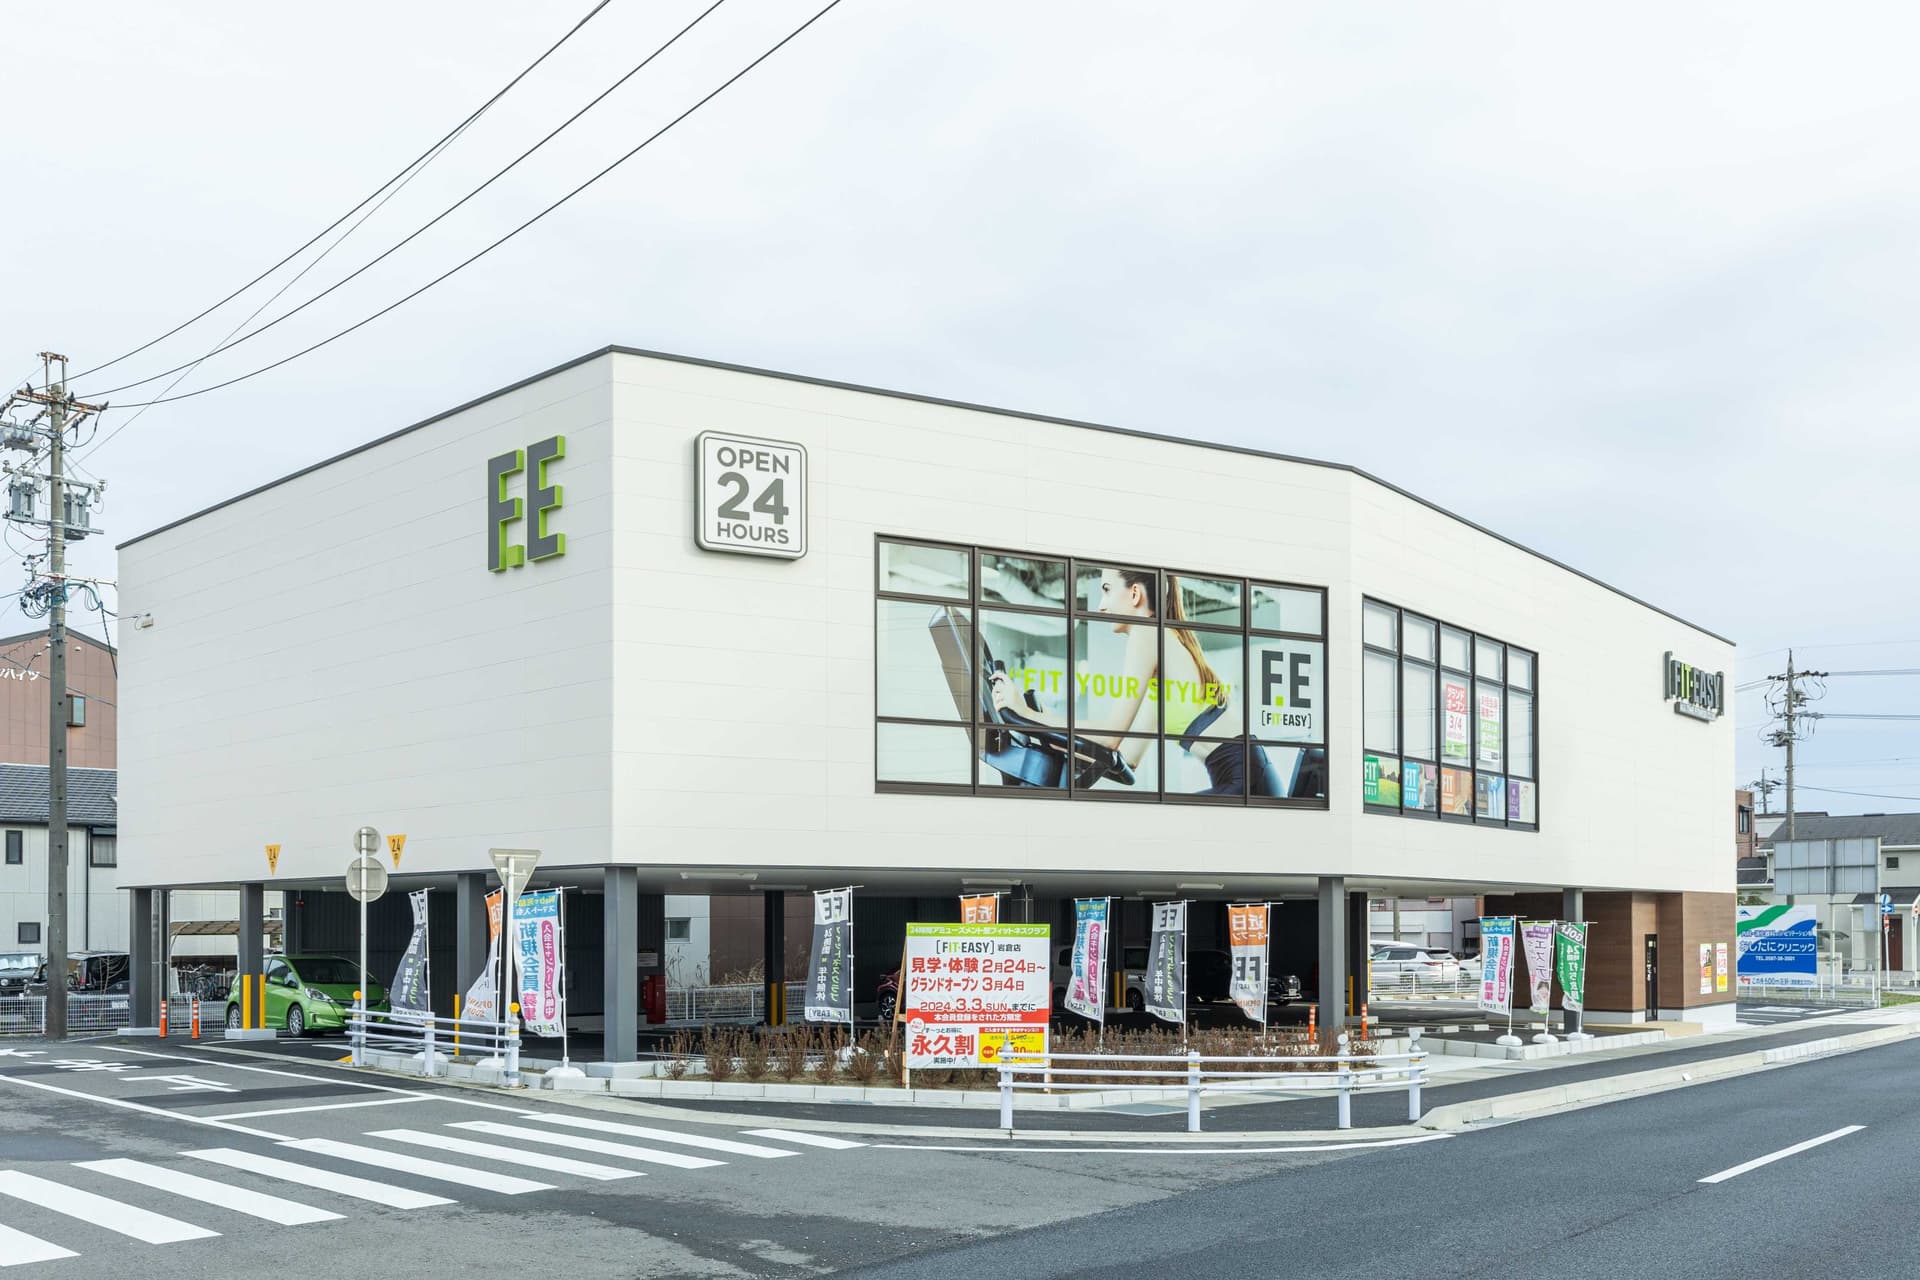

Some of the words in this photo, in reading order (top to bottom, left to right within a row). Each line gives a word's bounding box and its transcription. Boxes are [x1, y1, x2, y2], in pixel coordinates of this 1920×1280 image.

[717, 446, 790, 475] OPEN
[717, 471, 790, 525] 24
[717, 521, 790, 544] HOURS
[1076, 672, 1139, 699] YOUR
[1449, 715, 1462, 730] 3/4
[1364, 761, 1377, 782] FIT
[1404, 768, 1417, 788] FIT
[1441, 774, 1454, 793] FIT
[268, 848, 277, 861] 24
[391, 838, 401, 853] 24
[997, 943, 1022, 952] 岩倉店
[911, 957, 979, 974] 見学・体験
[911, 977, 979, 992] グランドオープン
[982, 976, 1025, 992] 3月4日
[986, 1002, 1008, 1011] SUN
[1011, 1003, 1037, 1011] までに
[911, 1034, 975, 1056] 永久割
